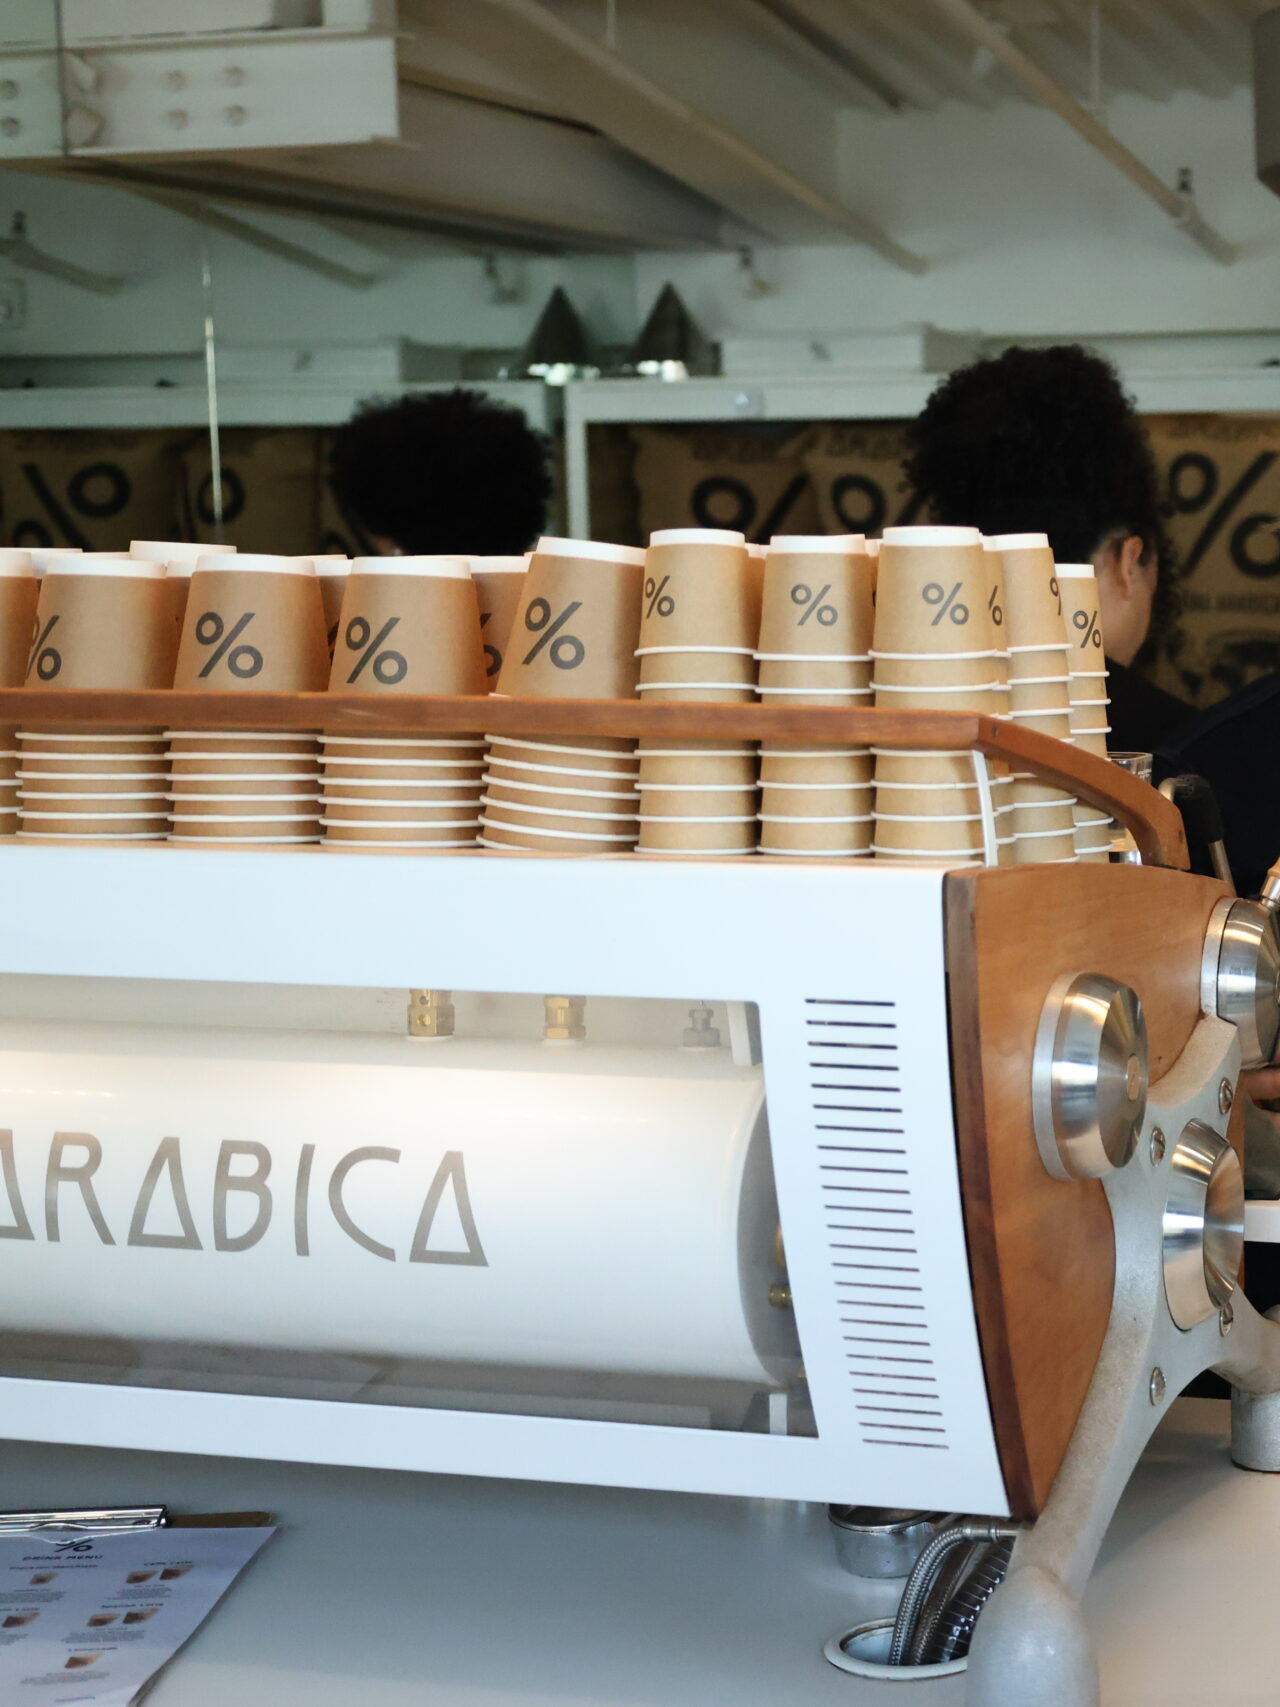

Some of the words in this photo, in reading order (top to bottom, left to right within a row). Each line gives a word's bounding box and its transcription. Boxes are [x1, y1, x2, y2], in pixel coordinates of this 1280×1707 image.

[790, 583, 839, 627] %
[922, 582, 970, 627] %
[1072, 610, 1102, 649] %
[195, 611, 264, 679] %
[345, 616, 408, 685] %
[522, 597, 586, 670] %
